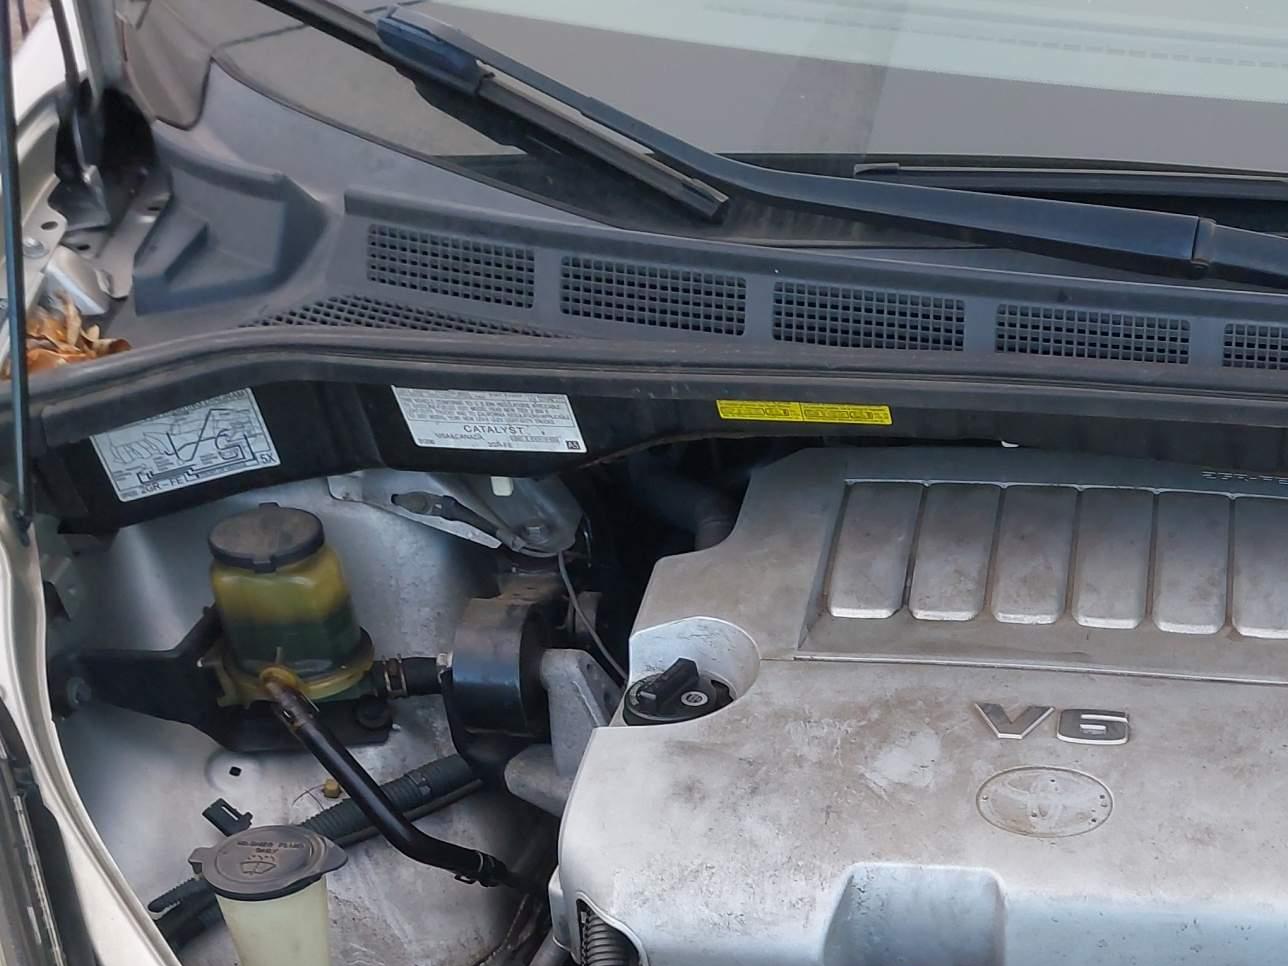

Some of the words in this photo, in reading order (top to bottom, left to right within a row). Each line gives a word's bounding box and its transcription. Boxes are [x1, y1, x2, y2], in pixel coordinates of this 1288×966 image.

[463, 424, 525, 435] CATALYST
[260, 452, 277, 464] 5X
[975, 702, 1130, 745] V6
